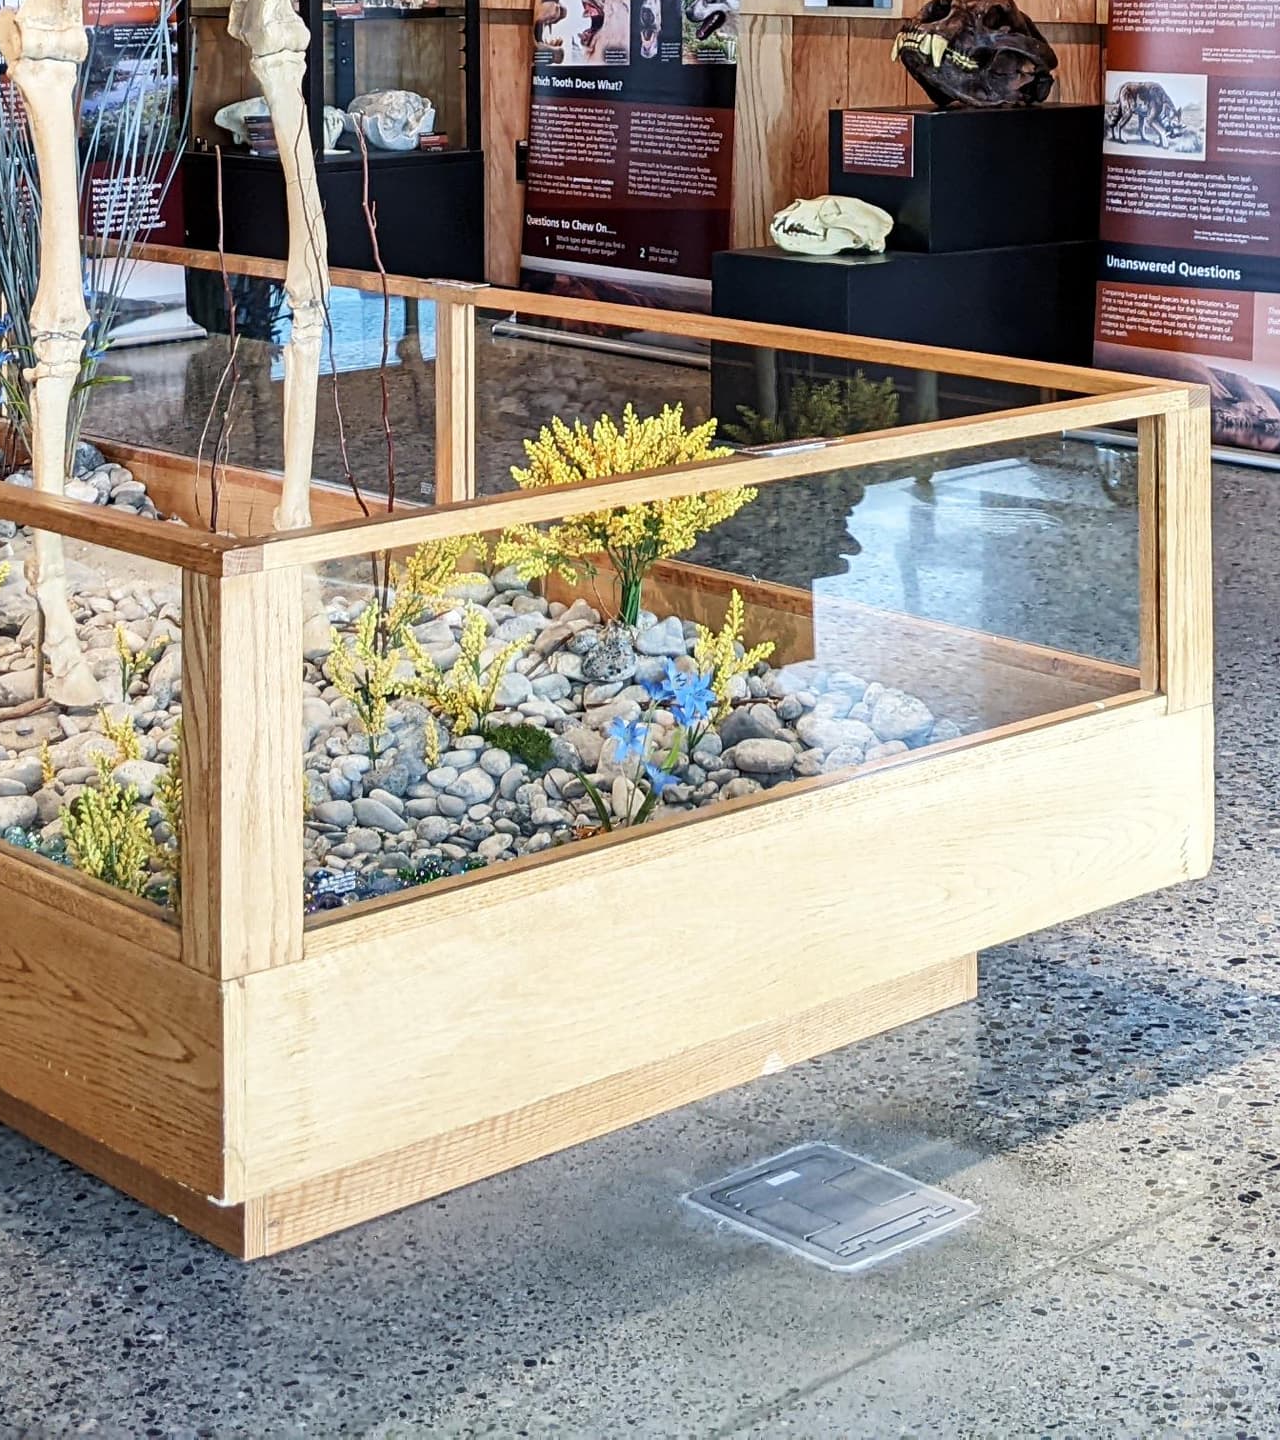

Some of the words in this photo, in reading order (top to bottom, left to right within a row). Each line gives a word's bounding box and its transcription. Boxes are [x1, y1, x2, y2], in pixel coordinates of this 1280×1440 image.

[533, 76, 550, 86] Which
[552, 77, 573, 87] Tooth
[575, 78, 595, 89] Does
[598, 80, 622, 91] What?
[527, 215, 559, 227] Questions
[562, 218, 570, 228] to
[572, 219, 594, 231] Chew
[1107, 255, 1175, 274] Unanswered
[1179, 262, 1241, 280] Questions
